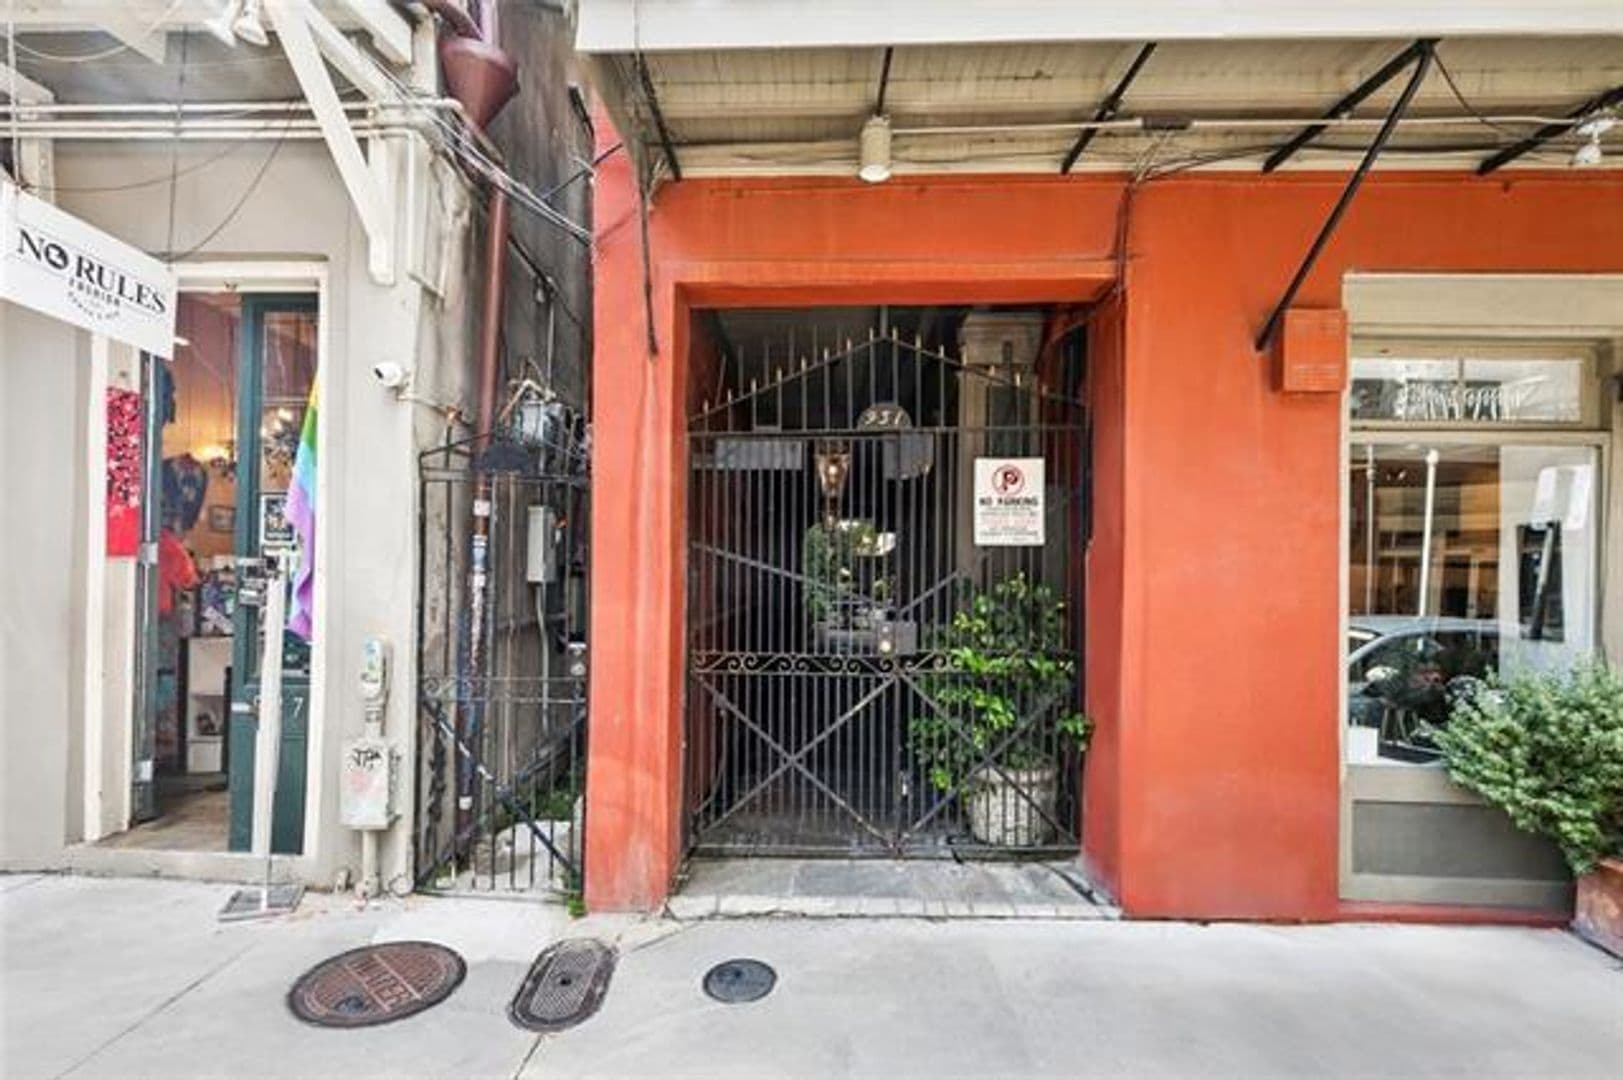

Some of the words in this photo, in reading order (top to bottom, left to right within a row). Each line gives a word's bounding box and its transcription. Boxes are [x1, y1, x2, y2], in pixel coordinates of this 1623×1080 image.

[17, 227, 69, 270] NO
[76, 255, 166, 314] RULES
[998, 497, 1039, 506] PARKING
